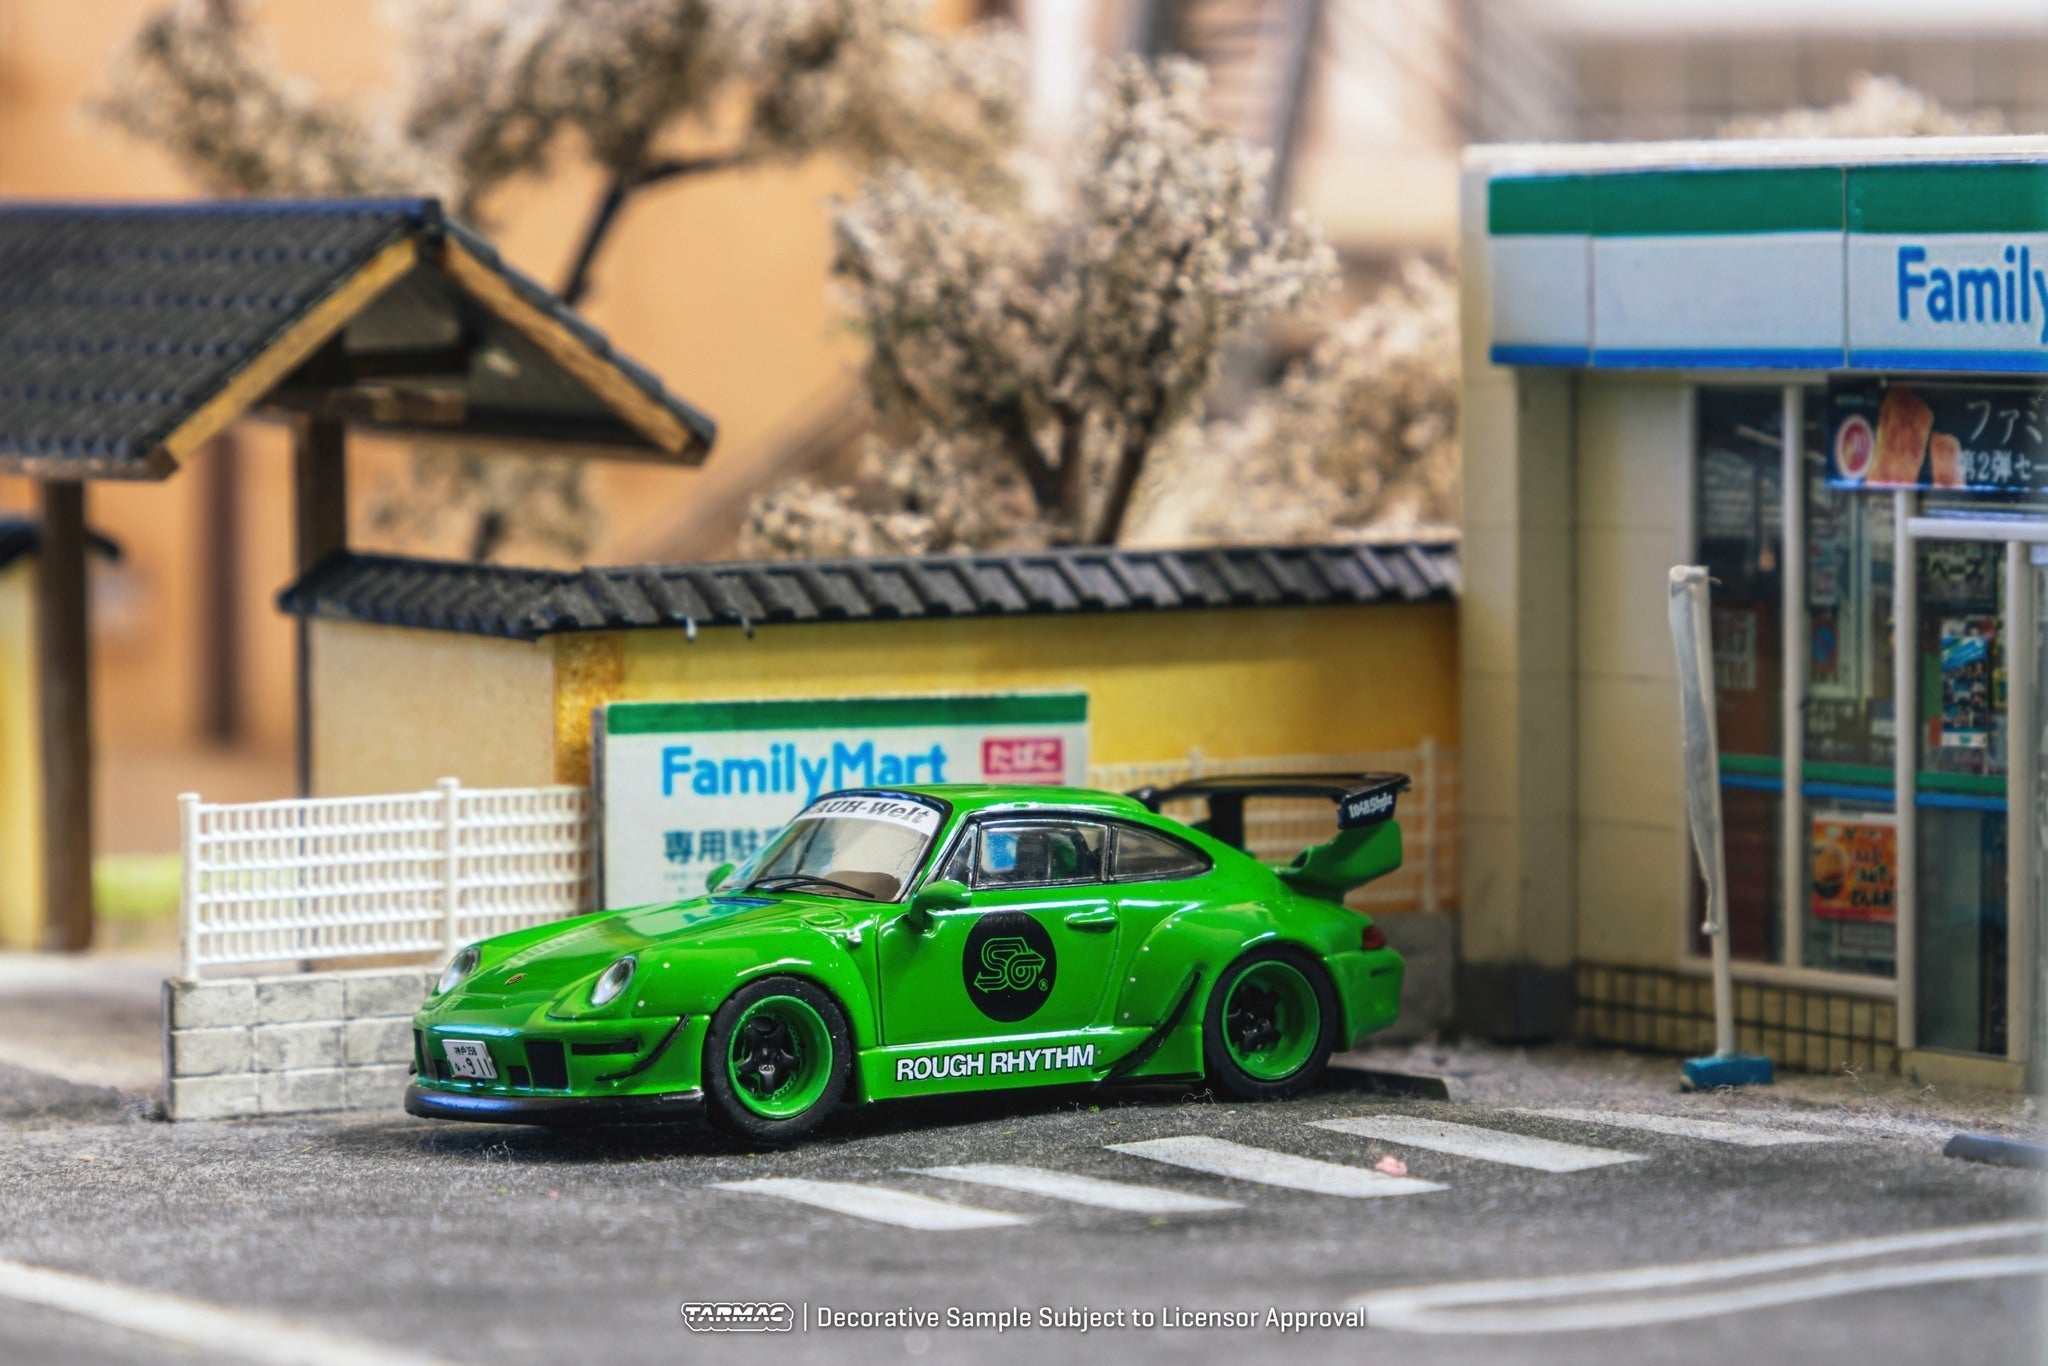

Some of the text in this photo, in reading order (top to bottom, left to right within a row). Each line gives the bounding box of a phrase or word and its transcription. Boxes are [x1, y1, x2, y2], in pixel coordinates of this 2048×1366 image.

[662, 741, 947, 806] FamilyMart
[896, 1043, 1095, 1082] ROUGH RHYTHM
